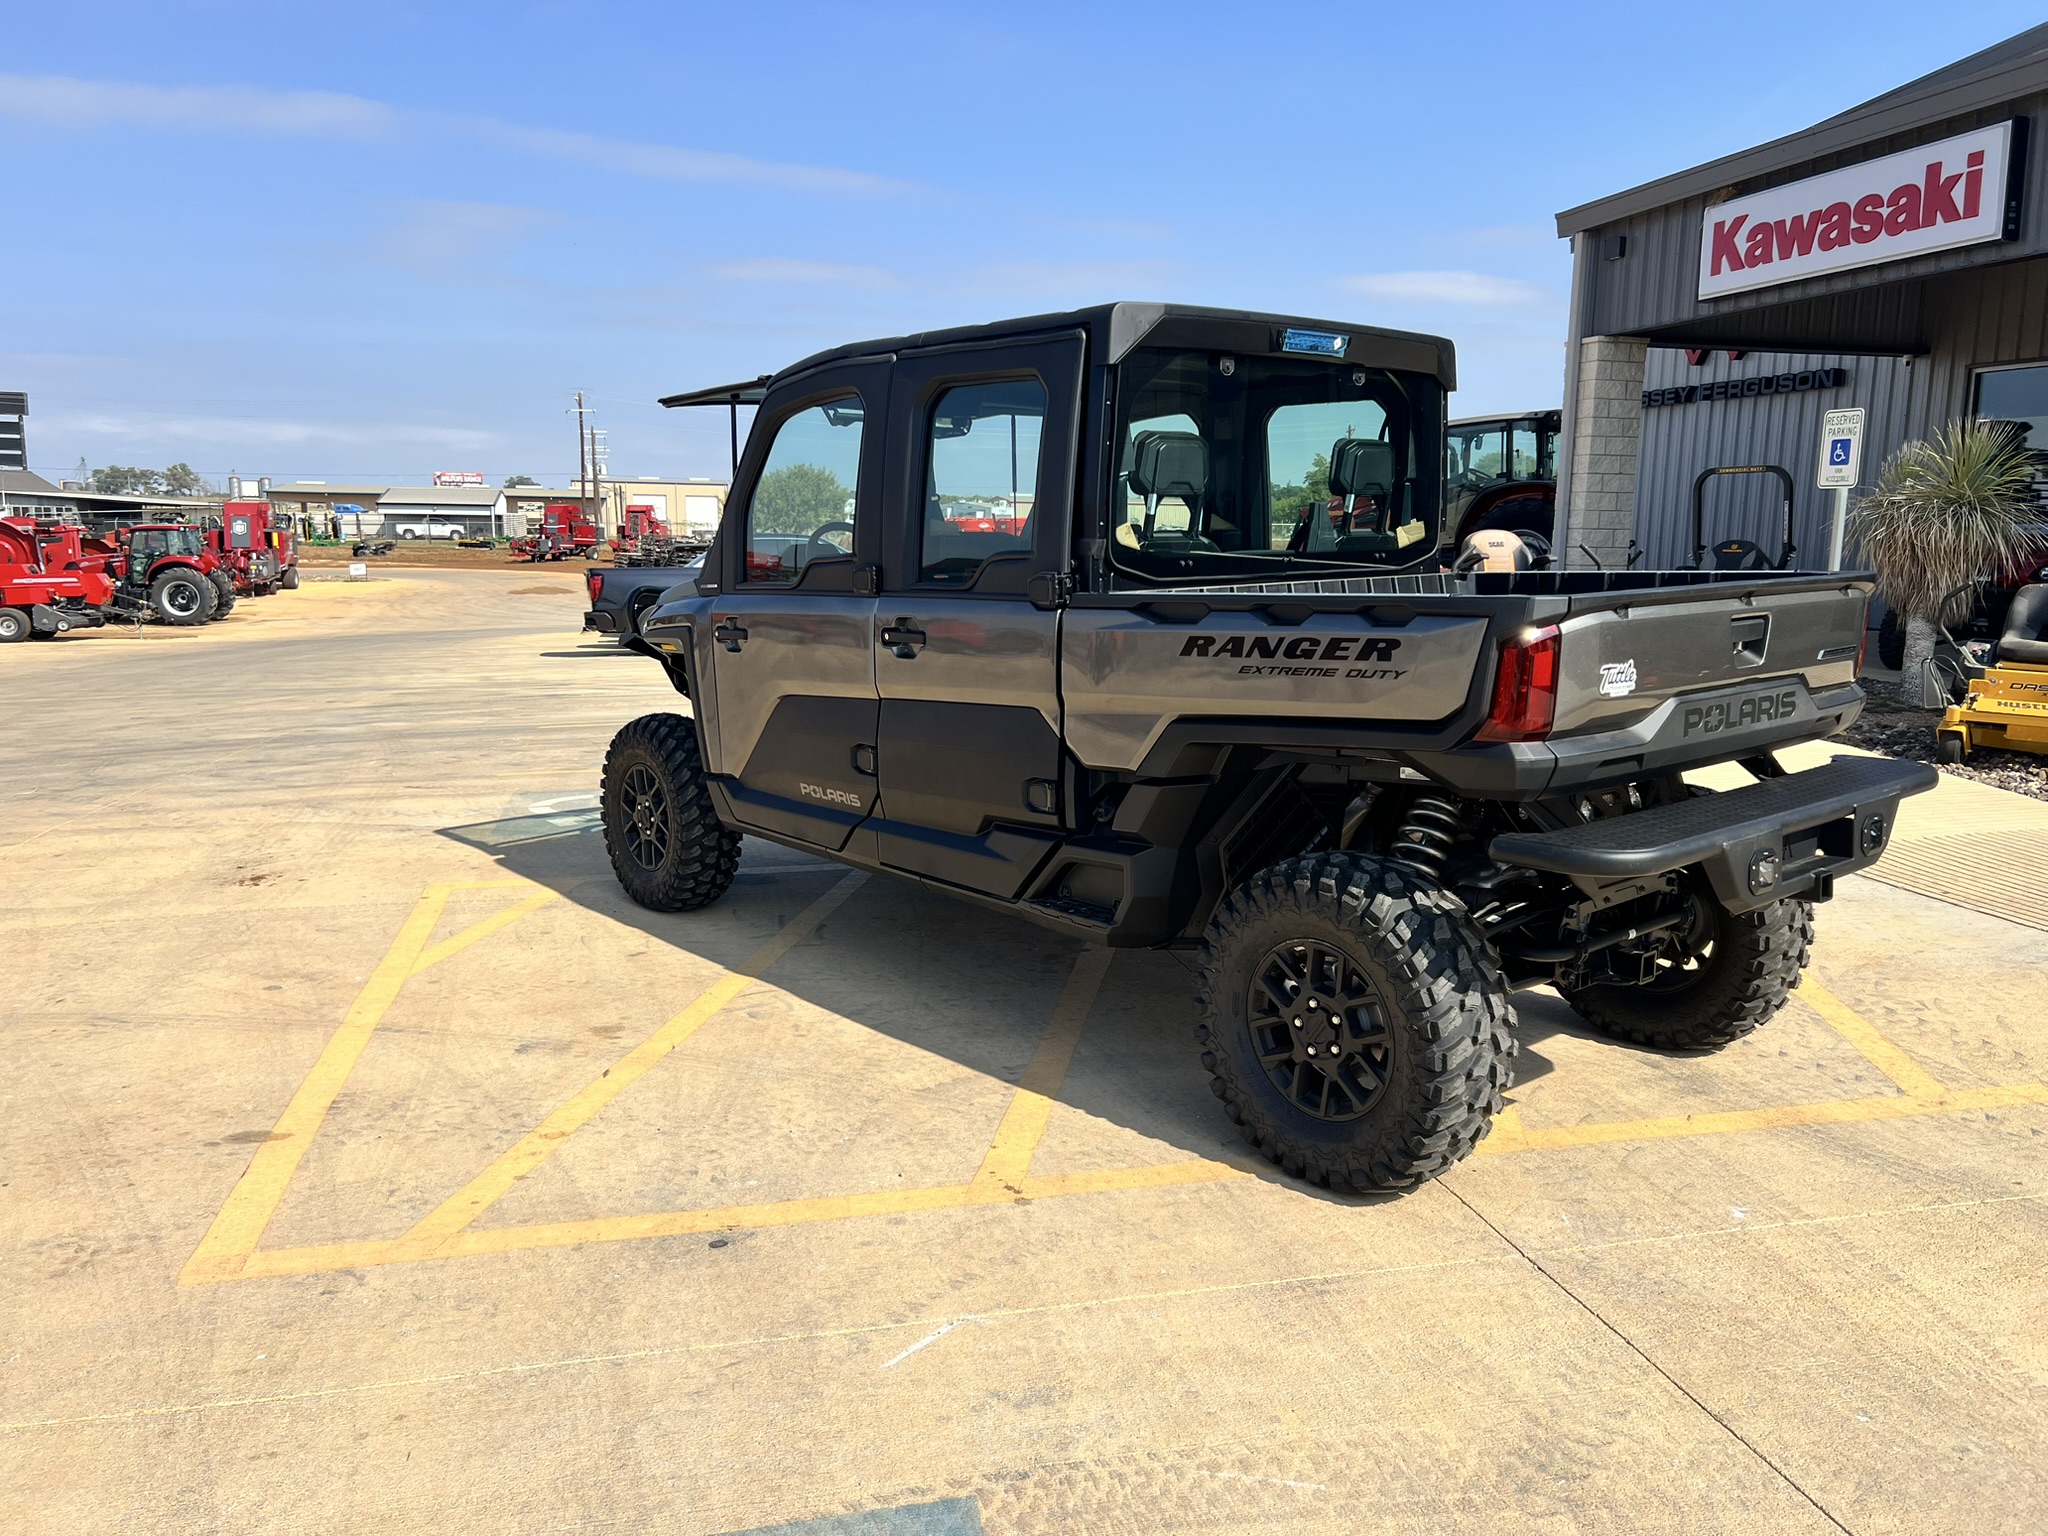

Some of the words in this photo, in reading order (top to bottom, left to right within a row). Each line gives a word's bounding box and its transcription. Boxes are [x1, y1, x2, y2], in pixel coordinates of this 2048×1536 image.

[1710, 150, 1985, 276] Kawasaki
[1700, 368, 1835, 401] FERGUSON
[1827, 414, 1861, 426] RESERVED
[1828, 426, 1857, 437] PARKING
[1179, 636, 1402, 662] RANGER
[1238, 665, 1339, 677] EXTREME
[1345, 669, 1409, 680] DUTY
[1602, 661, 1635, 691] Tuttle
[1683, 691, 1796, 738] POLARIS
[800, 783, 861, 807] POLARIS
